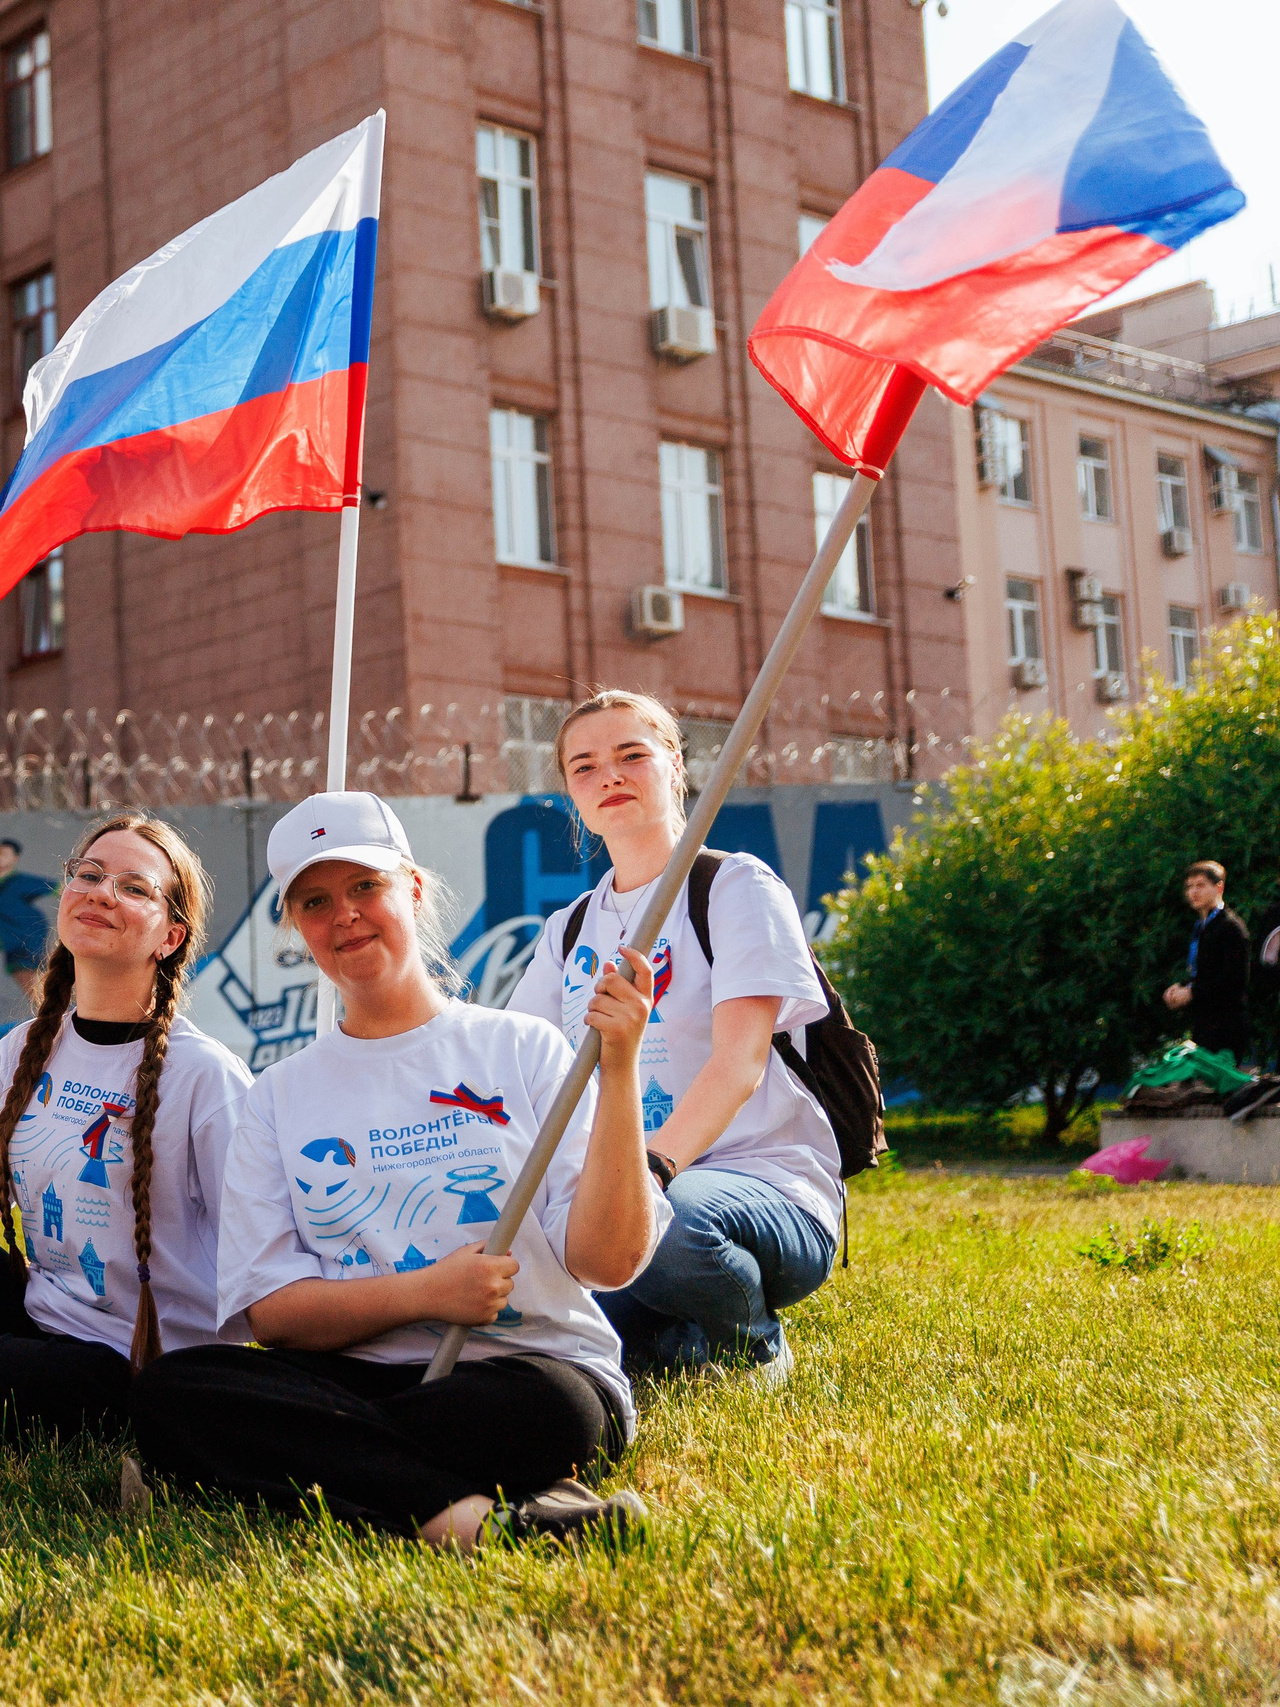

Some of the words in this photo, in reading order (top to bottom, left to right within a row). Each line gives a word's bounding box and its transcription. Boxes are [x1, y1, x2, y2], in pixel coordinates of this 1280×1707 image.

[56, 1095, 102, 1117] ПОБЕД
[62, 1080, 138, 1111] ВОЛОНТЁР
[51, 1111, 87, 1126] Нижегород
[369, 1109, 494, 1142] ВОЛОНТЁРЫ
[370, 1132, 458, 1159] ПОБЕДЫ
[372, 1151, 456, 1174] Нижегородской
[458, 1146, 502, 1159] области
